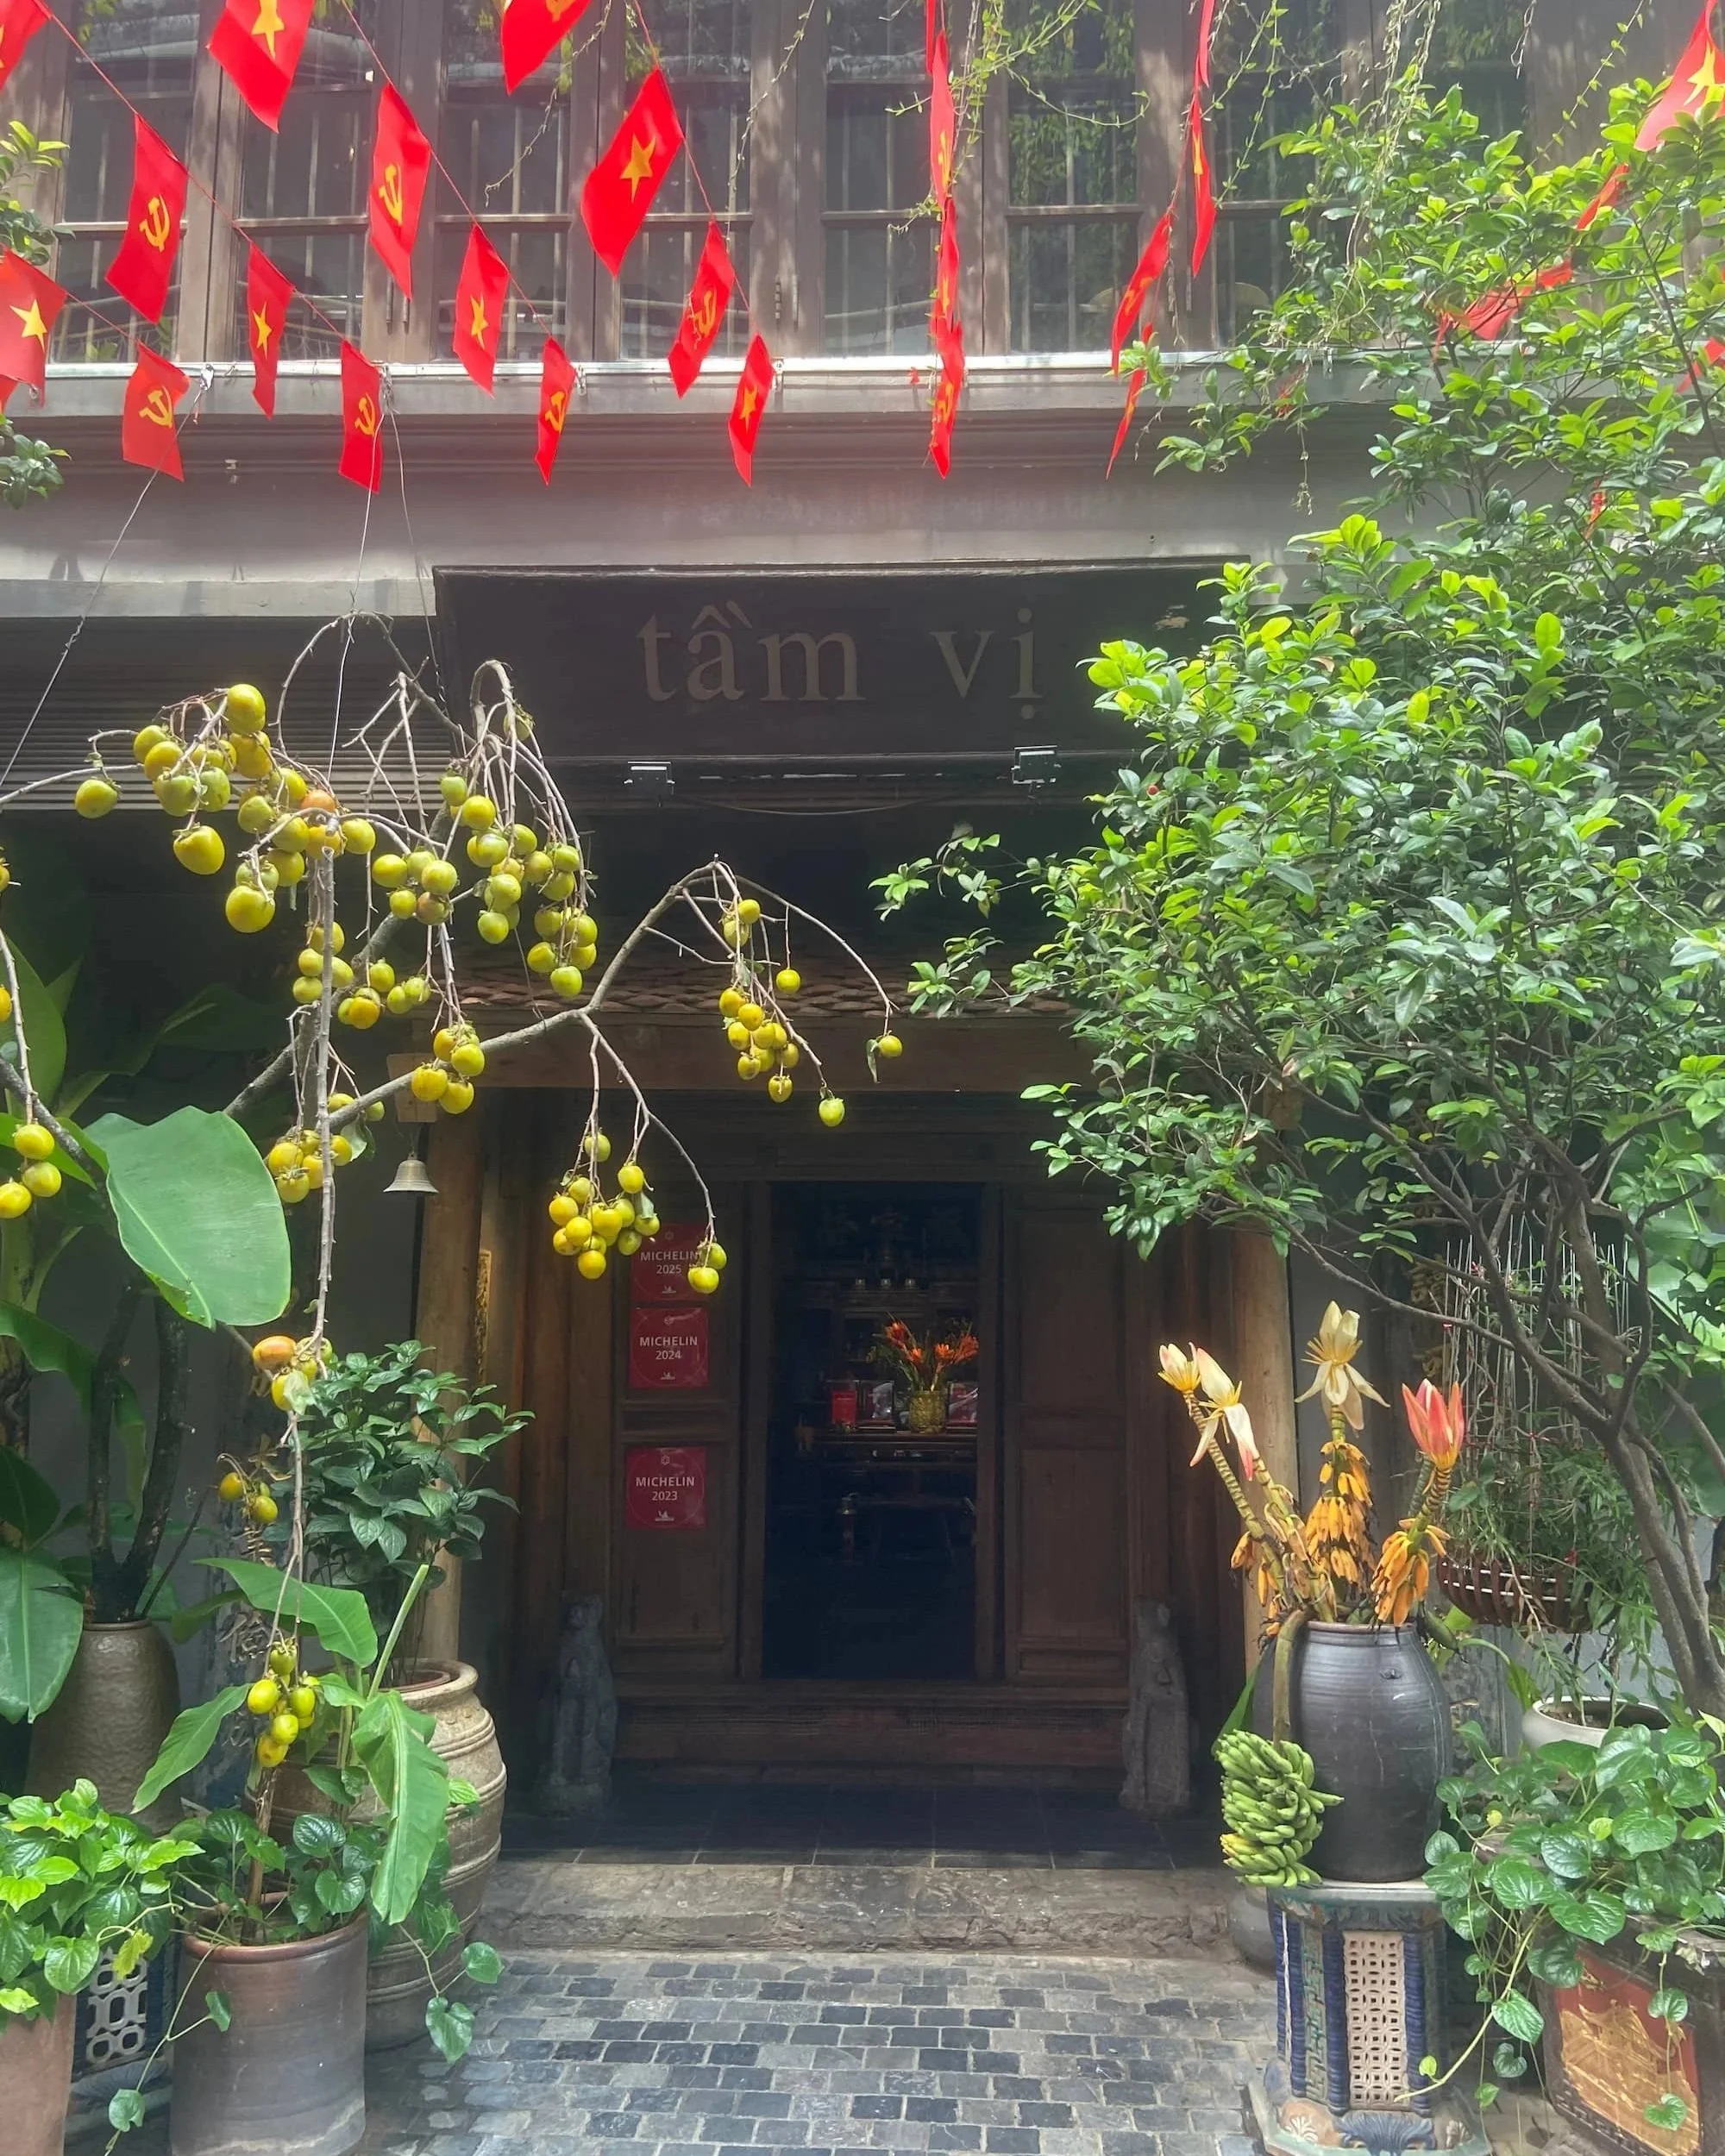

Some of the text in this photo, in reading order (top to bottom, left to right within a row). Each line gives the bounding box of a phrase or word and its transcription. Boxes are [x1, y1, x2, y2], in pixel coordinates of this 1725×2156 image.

[636, 600, 1044, 720] tầm vị
[640, 1250, 699, 1262] MICHELIN
[656, 1264, 682, 1275] 2025
[639, 1336, 698, 1347] MICHELIN
[655, 1350, 682, 1361] 2024
[635, 1476, 695, 1487] MICHELIN
[651, 1490, 678, 1501] 2023
